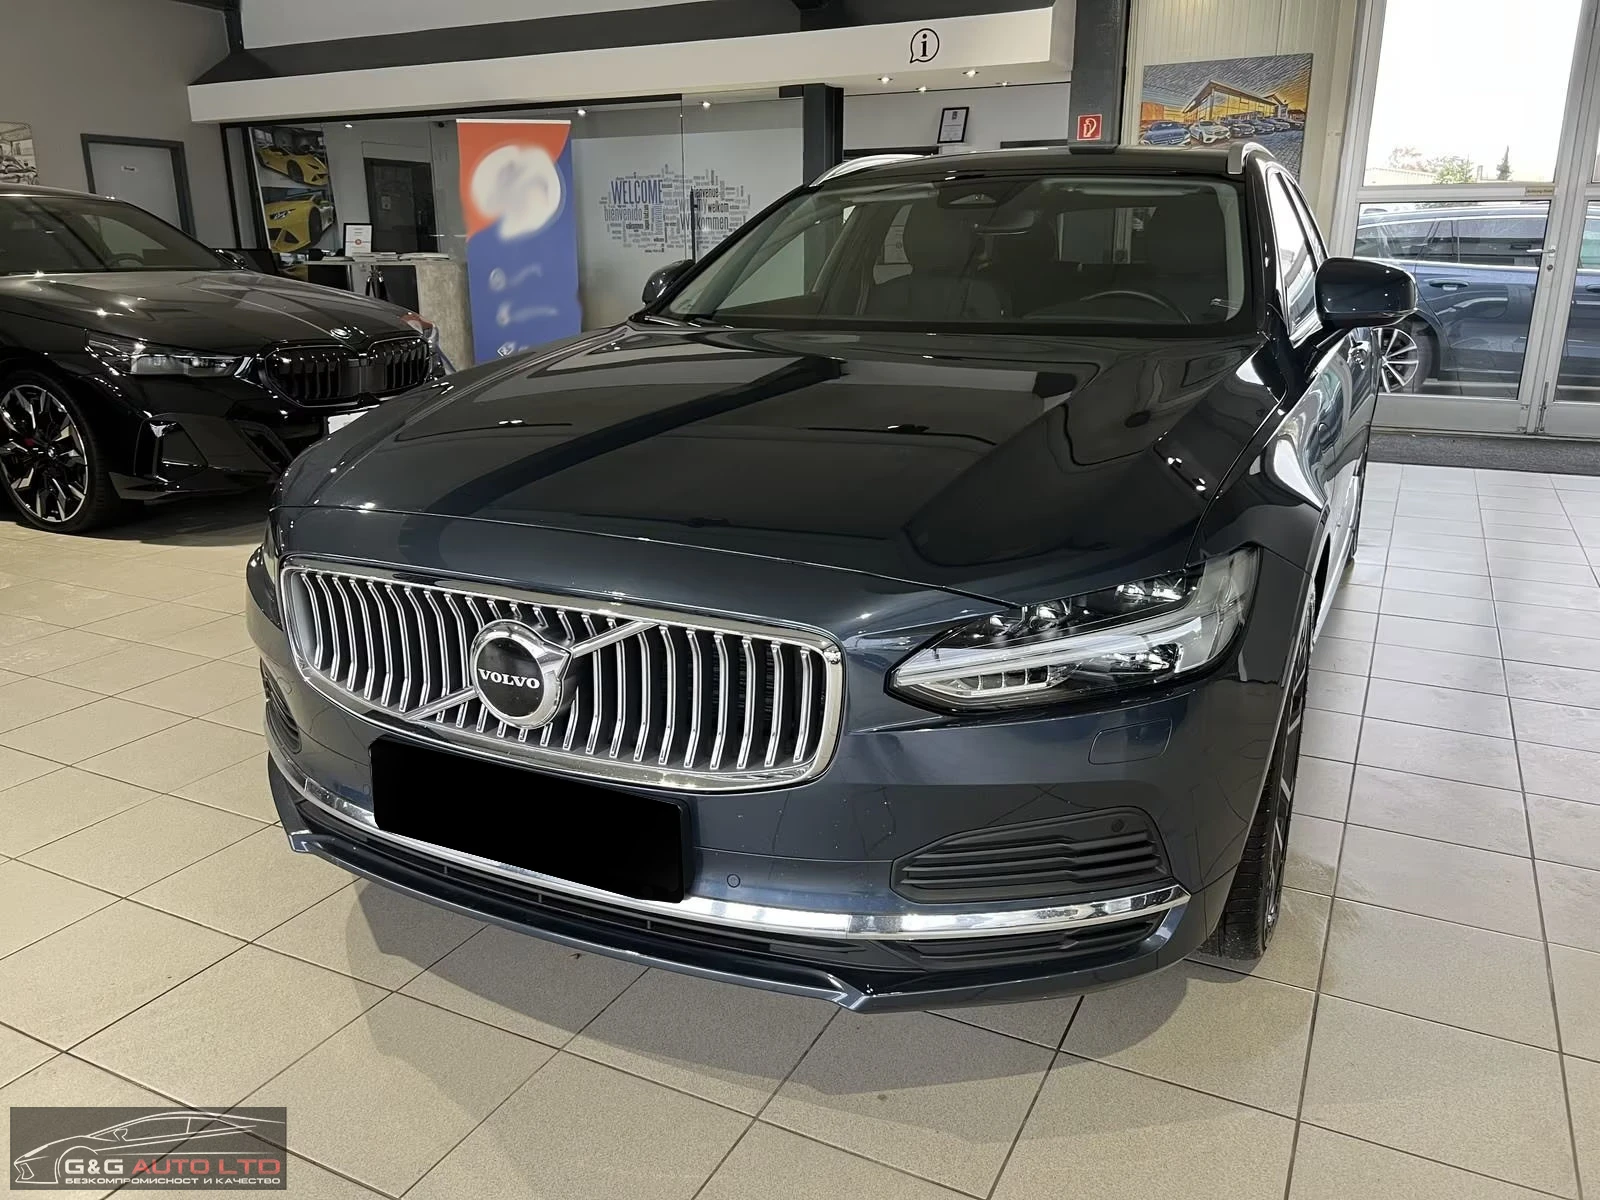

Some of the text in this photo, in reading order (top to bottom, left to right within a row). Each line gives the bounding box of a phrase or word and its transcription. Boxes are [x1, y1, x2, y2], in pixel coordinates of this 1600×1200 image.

[611, 179, 664, 205] WELCOME
[691, 185, 719, 198] ienvenue
[604, 203, 643, 222] bienvenido
[680, 212, 729, 230] Wkommen
[477, 667, 541, 689] VOLVO
